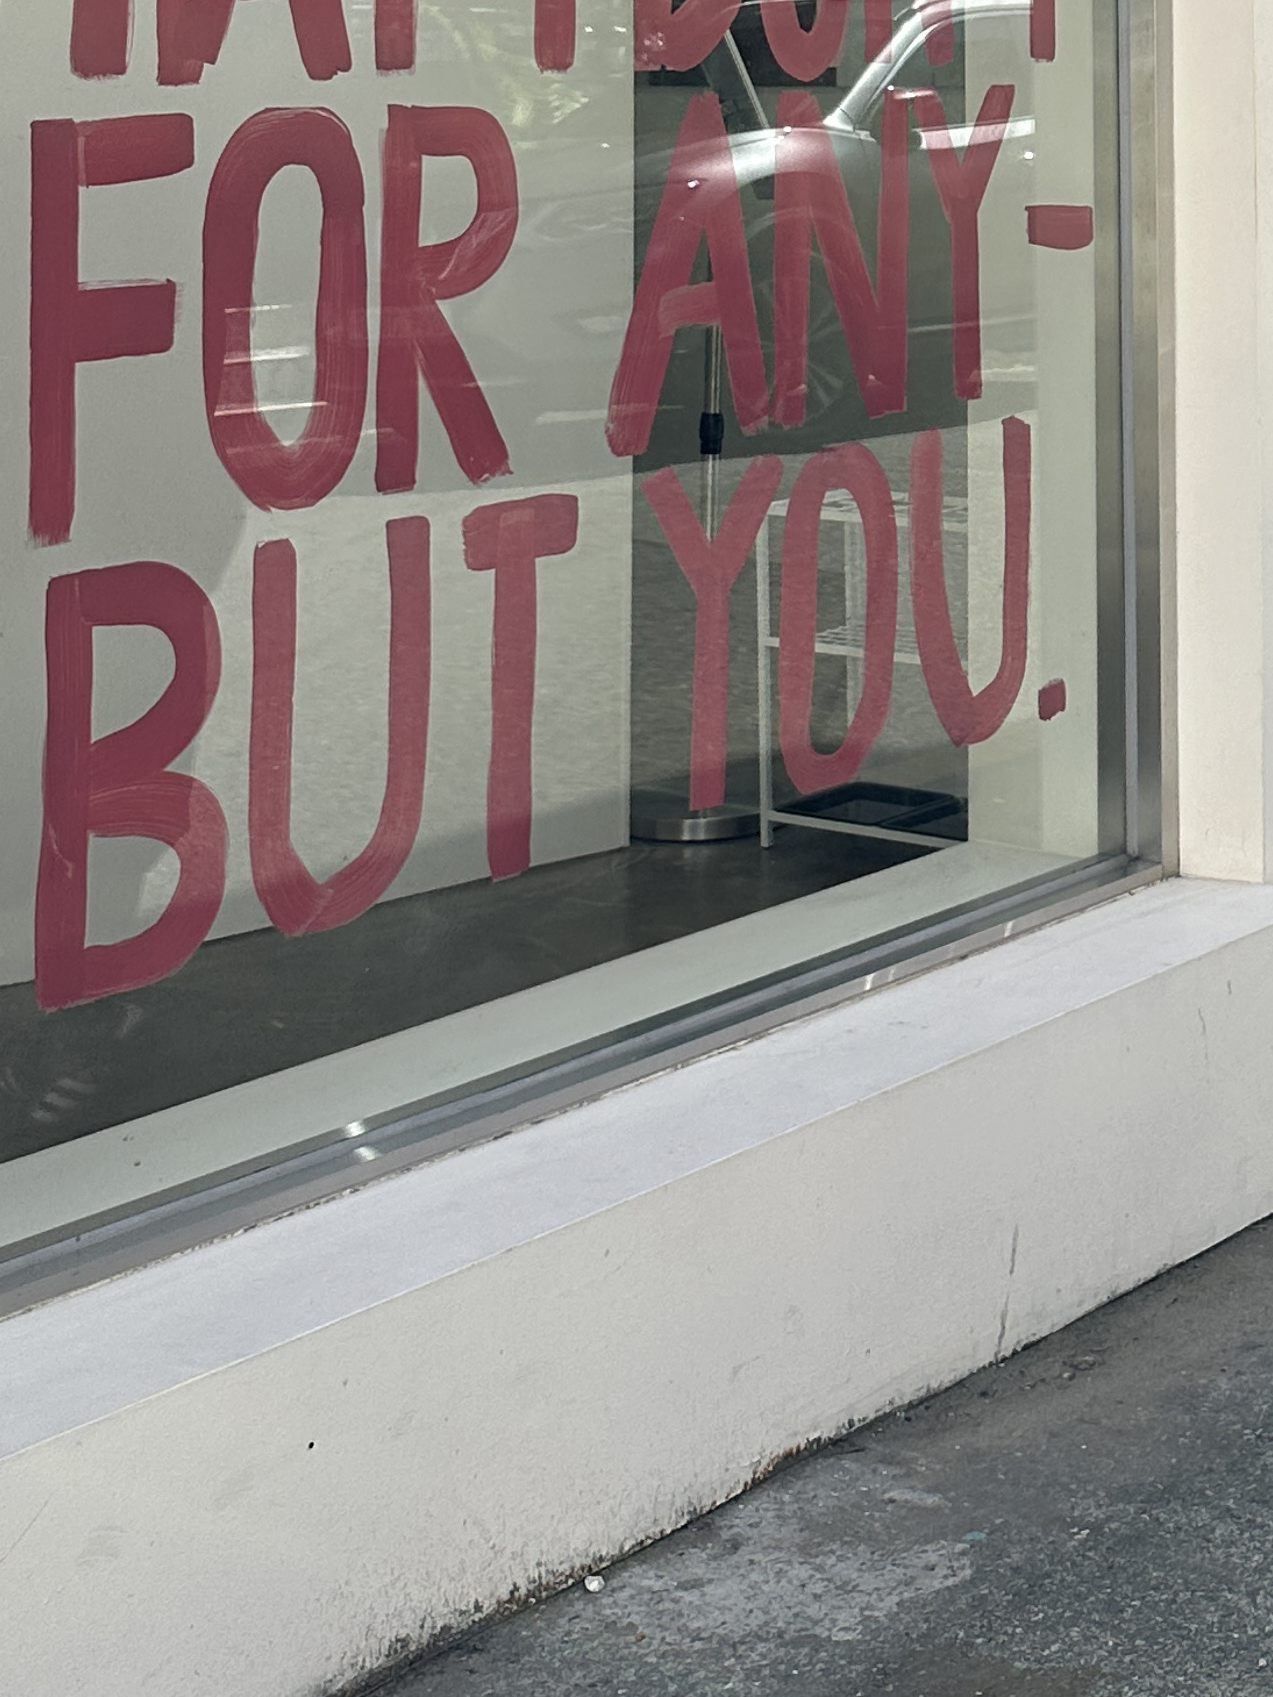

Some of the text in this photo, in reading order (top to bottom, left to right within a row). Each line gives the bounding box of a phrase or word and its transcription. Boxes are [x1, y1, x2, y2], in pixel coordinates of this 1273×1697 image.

[28, 104, 519, 547] FOR
[34, 415, 1067, 1011] BUT YOU.
